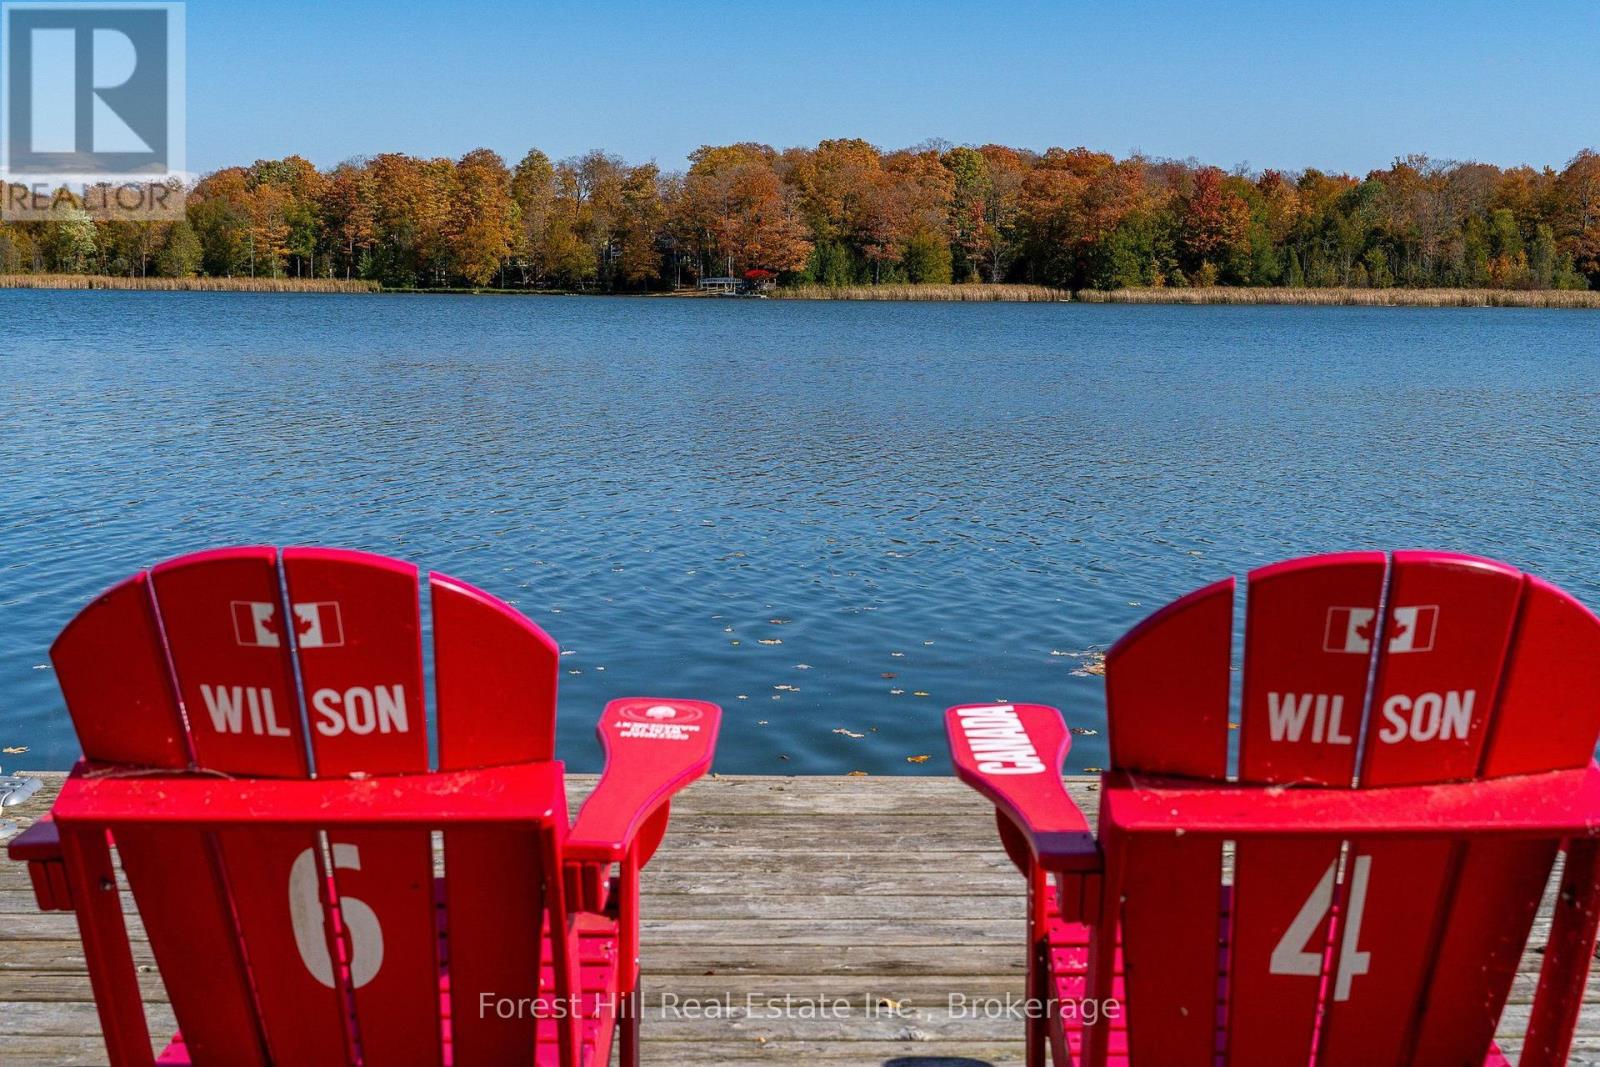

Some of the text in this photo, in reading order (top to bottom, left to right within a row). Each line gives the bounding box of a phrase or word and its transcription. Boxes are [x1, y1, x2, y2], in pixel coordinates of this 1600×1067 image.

[956, 705, 1046, 775] CANADA
[288, 843, 385, 989] 6
[1269, 855, 1372, 1001] 4
